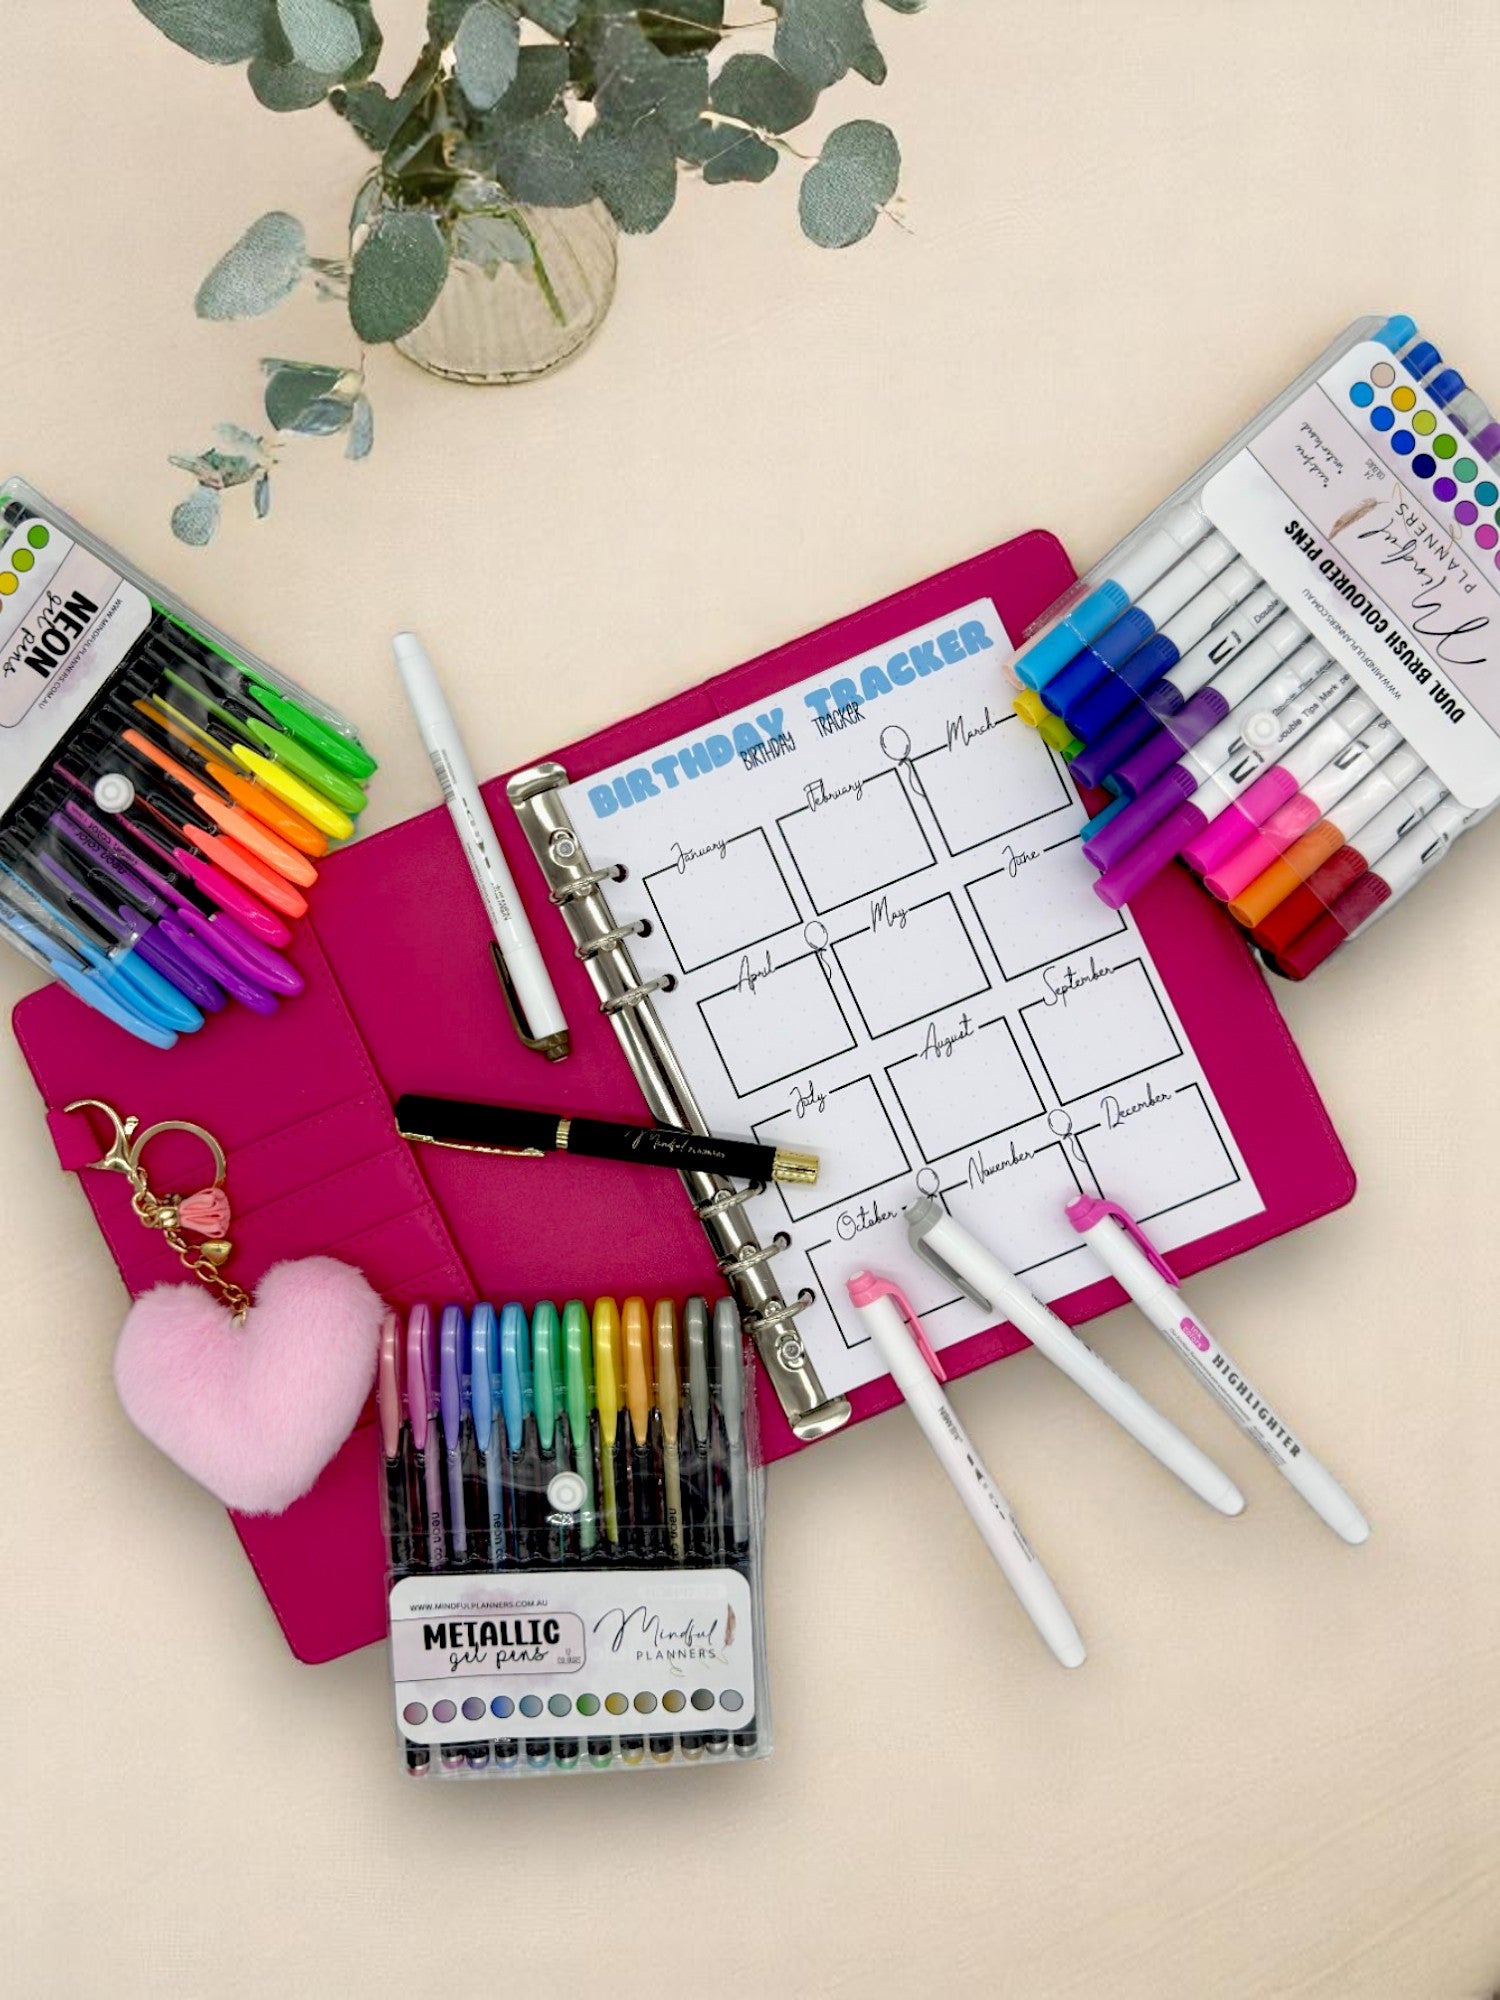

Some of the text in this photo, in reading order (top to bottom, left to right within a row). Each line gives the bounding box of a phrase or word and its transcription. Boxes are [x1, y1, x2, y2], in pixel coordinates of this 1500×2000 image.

[1395, 502, 1477, 595] PLANNERS
[1253, 599, 1280, 624] Double
[1357, 518, 1490, 664] Mindful
[3, 590, 62, 678] gel pens
[24, 590, 99, 679] NEON
[1284, 519, 1466, 724] DUAL BRUSH COLOURED PENS
[587, 619, 994, 819] BIRTHDAY TRACKER
[1301, 702, 1320, 718] Tips
[1318, 684, 1339, 702] Mark
[740, 701, 866, 772] BIRTHDAY TRACKER
[946, 707, 997, 752] March
[804, 778, 866, 812] February
[671, 842, 728, 875] January
[1002, 844, 1042, 878] June
[870, 895, 911, 932] May
[736, 951, 777, 997] April
[1042, 957, 1116, 1008] September
[920, 1013, 976, 1060] August
[789, 1080, 829, 1118] July
[1100, 1083, 1172, 1129] December
[967, 1142, 1036, 1190] November
[836, 1201, 898, 1242] October
[1212, 1354, 1301, 1457] HIGHLIGHTER
[423, 1618, 561, 1650] METALLIC
[593, 1605, 718, 1653] Mindful
[449, 1643, 550, 1672] gel pens
[636, 1649, 717, 1661] PLANNERS
